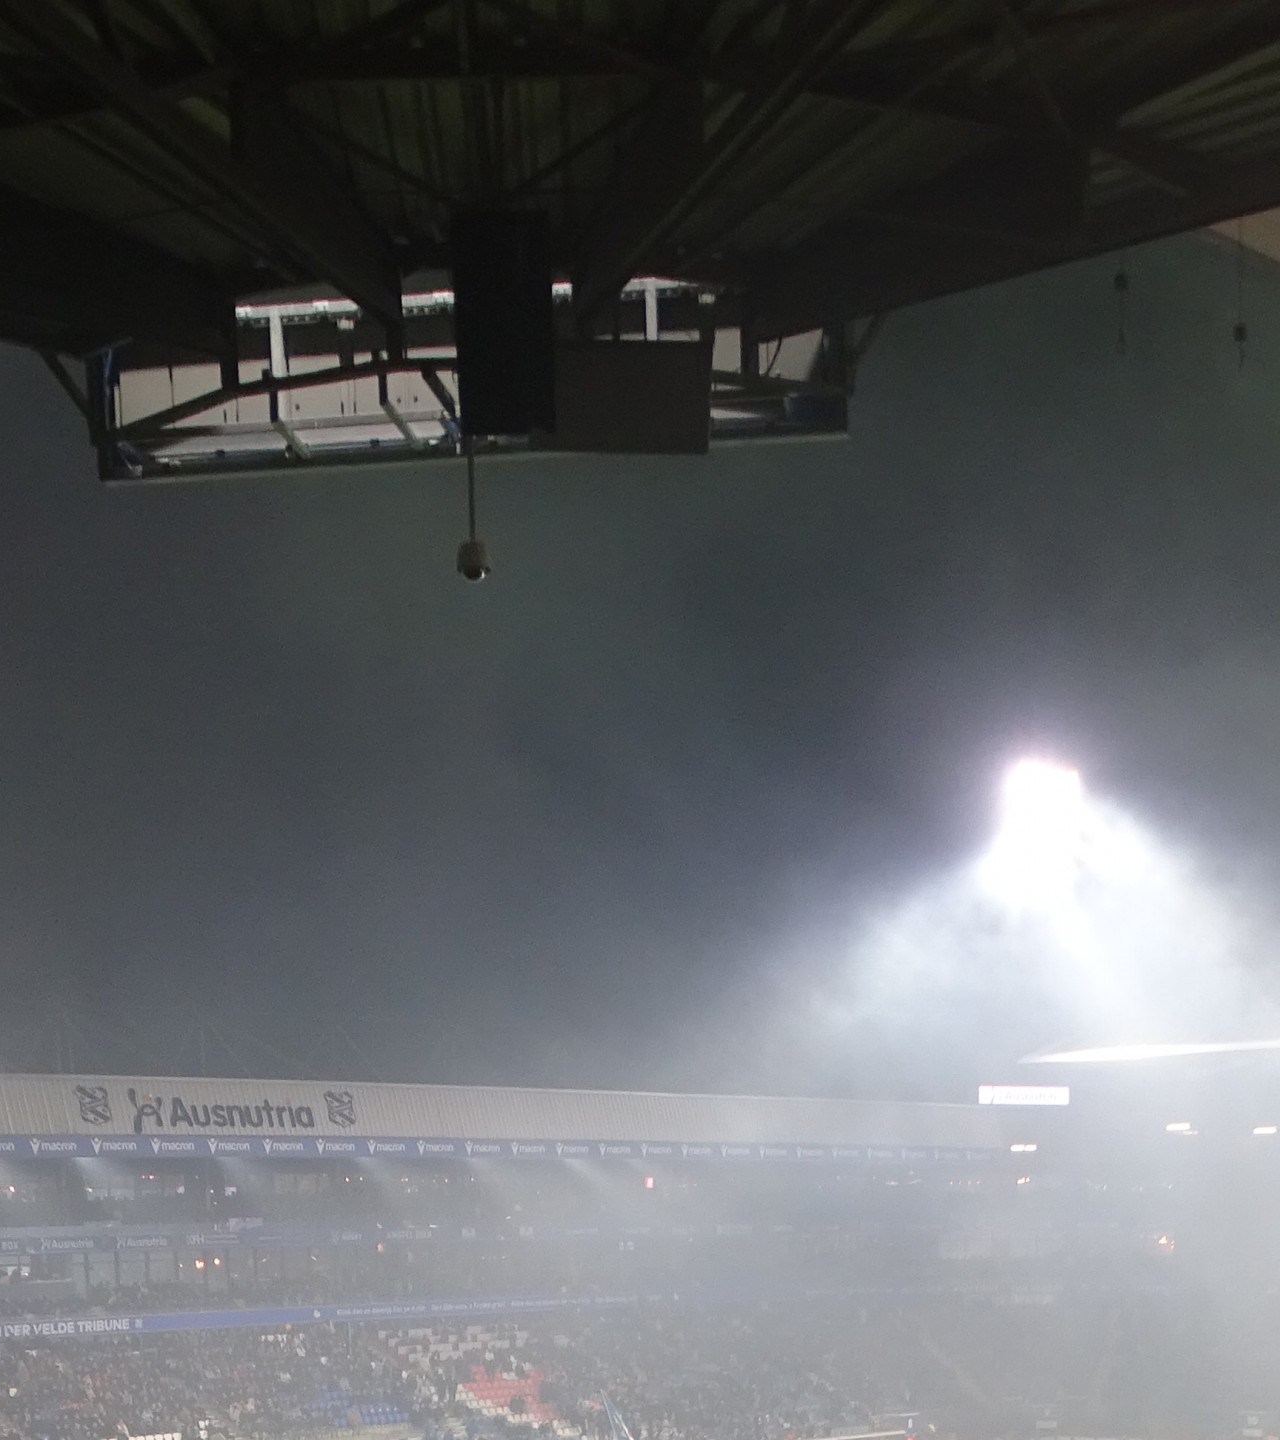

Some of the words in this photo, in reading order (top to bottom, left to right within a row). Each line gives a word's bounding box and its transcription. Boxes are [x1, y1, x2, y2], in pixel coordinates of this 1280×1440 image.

[170, 1096, 314, 1128] Ausnutria
[41, 1141, 77, 1151] macron
[103, 1141, 137, 1151] macron
[161, 1141, 195, 1151] macron
[1, 1240, 19, 1251] BOX
[51, 1239, 94, 1249] Ausnutria
[5, 1324, 31, 1338] DER
[33, 1322, 74, 1336] VELDE
[76, 1319, 130, 1334] TRIBUNE
